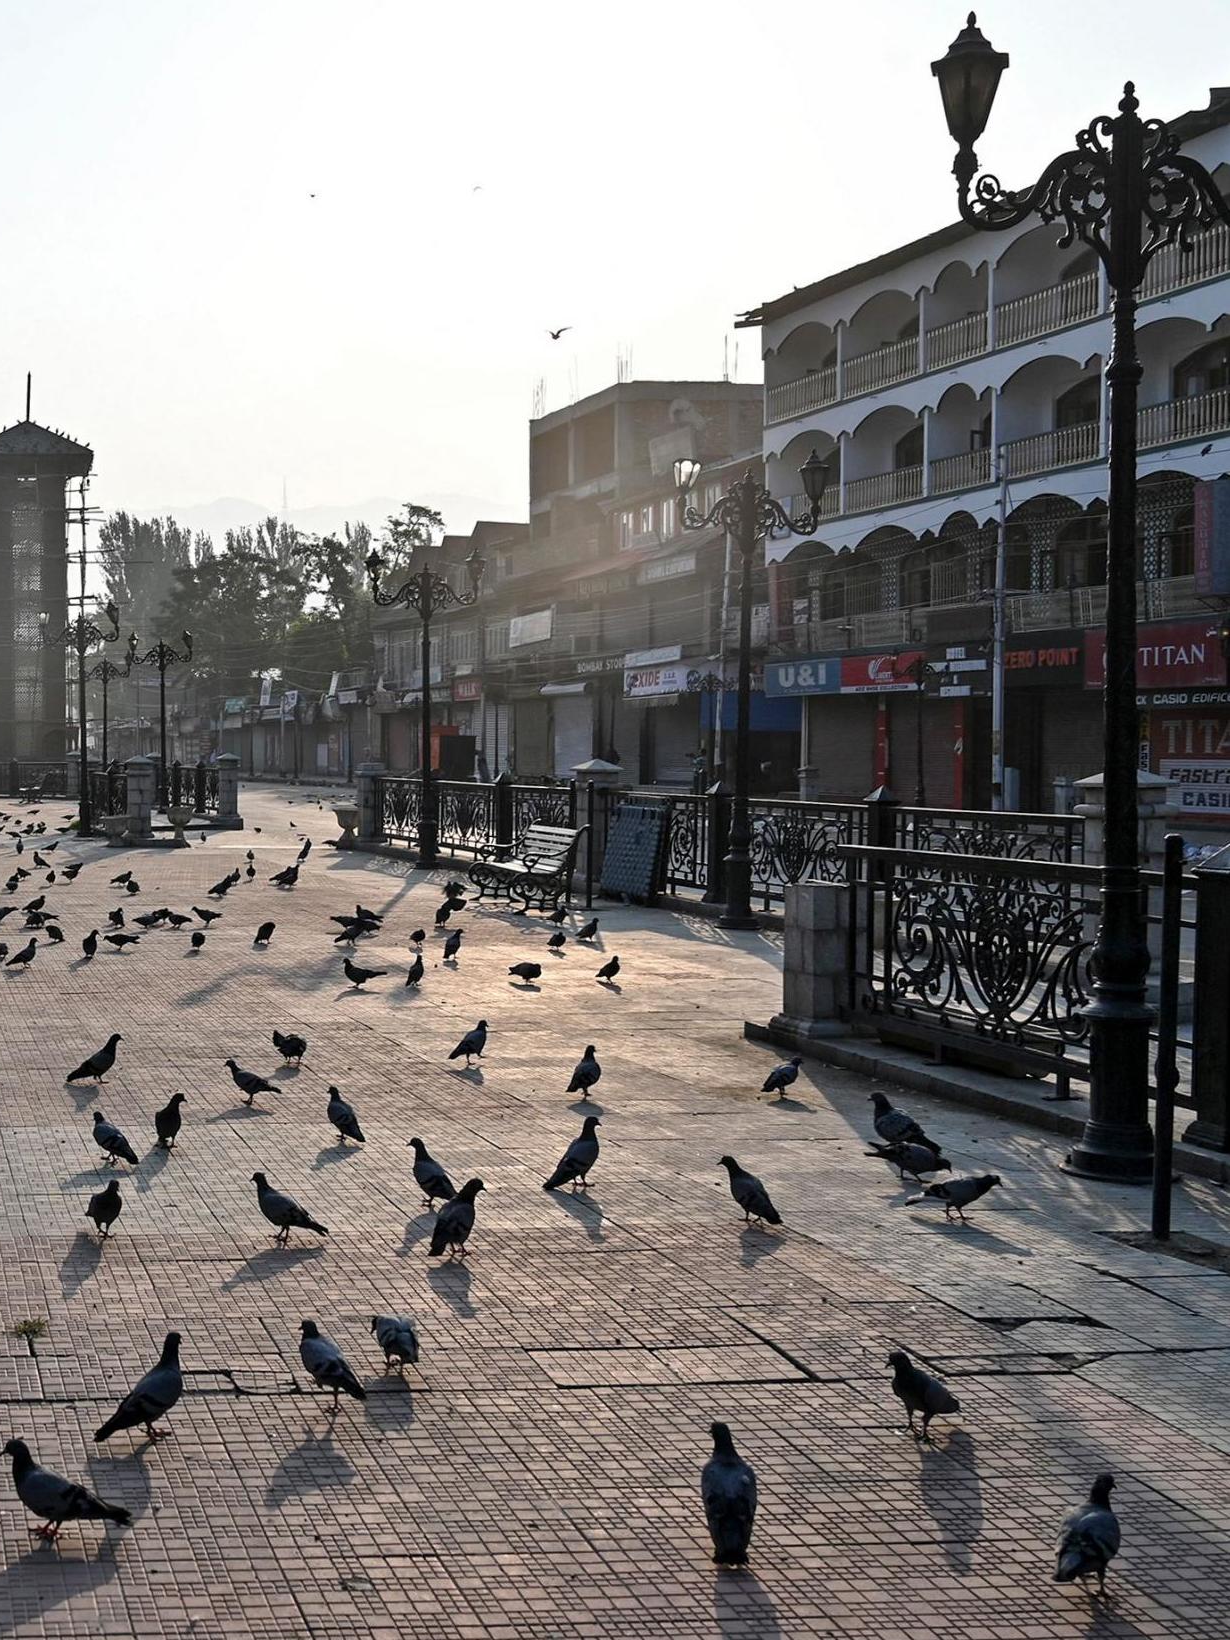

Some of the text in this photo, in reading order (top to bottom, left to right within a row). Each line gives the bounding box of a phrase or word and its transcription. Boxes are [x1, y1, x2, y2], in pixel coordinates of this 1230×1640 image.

[1038, 647, 1079, 667] POINT
[1139, 644, 1206, 666] TITAN
[578, 660, 603, 673] BOMBAY
[1153, 693, 1188, 705] CASIO
[1182, 792, 1230, 807] CASI
